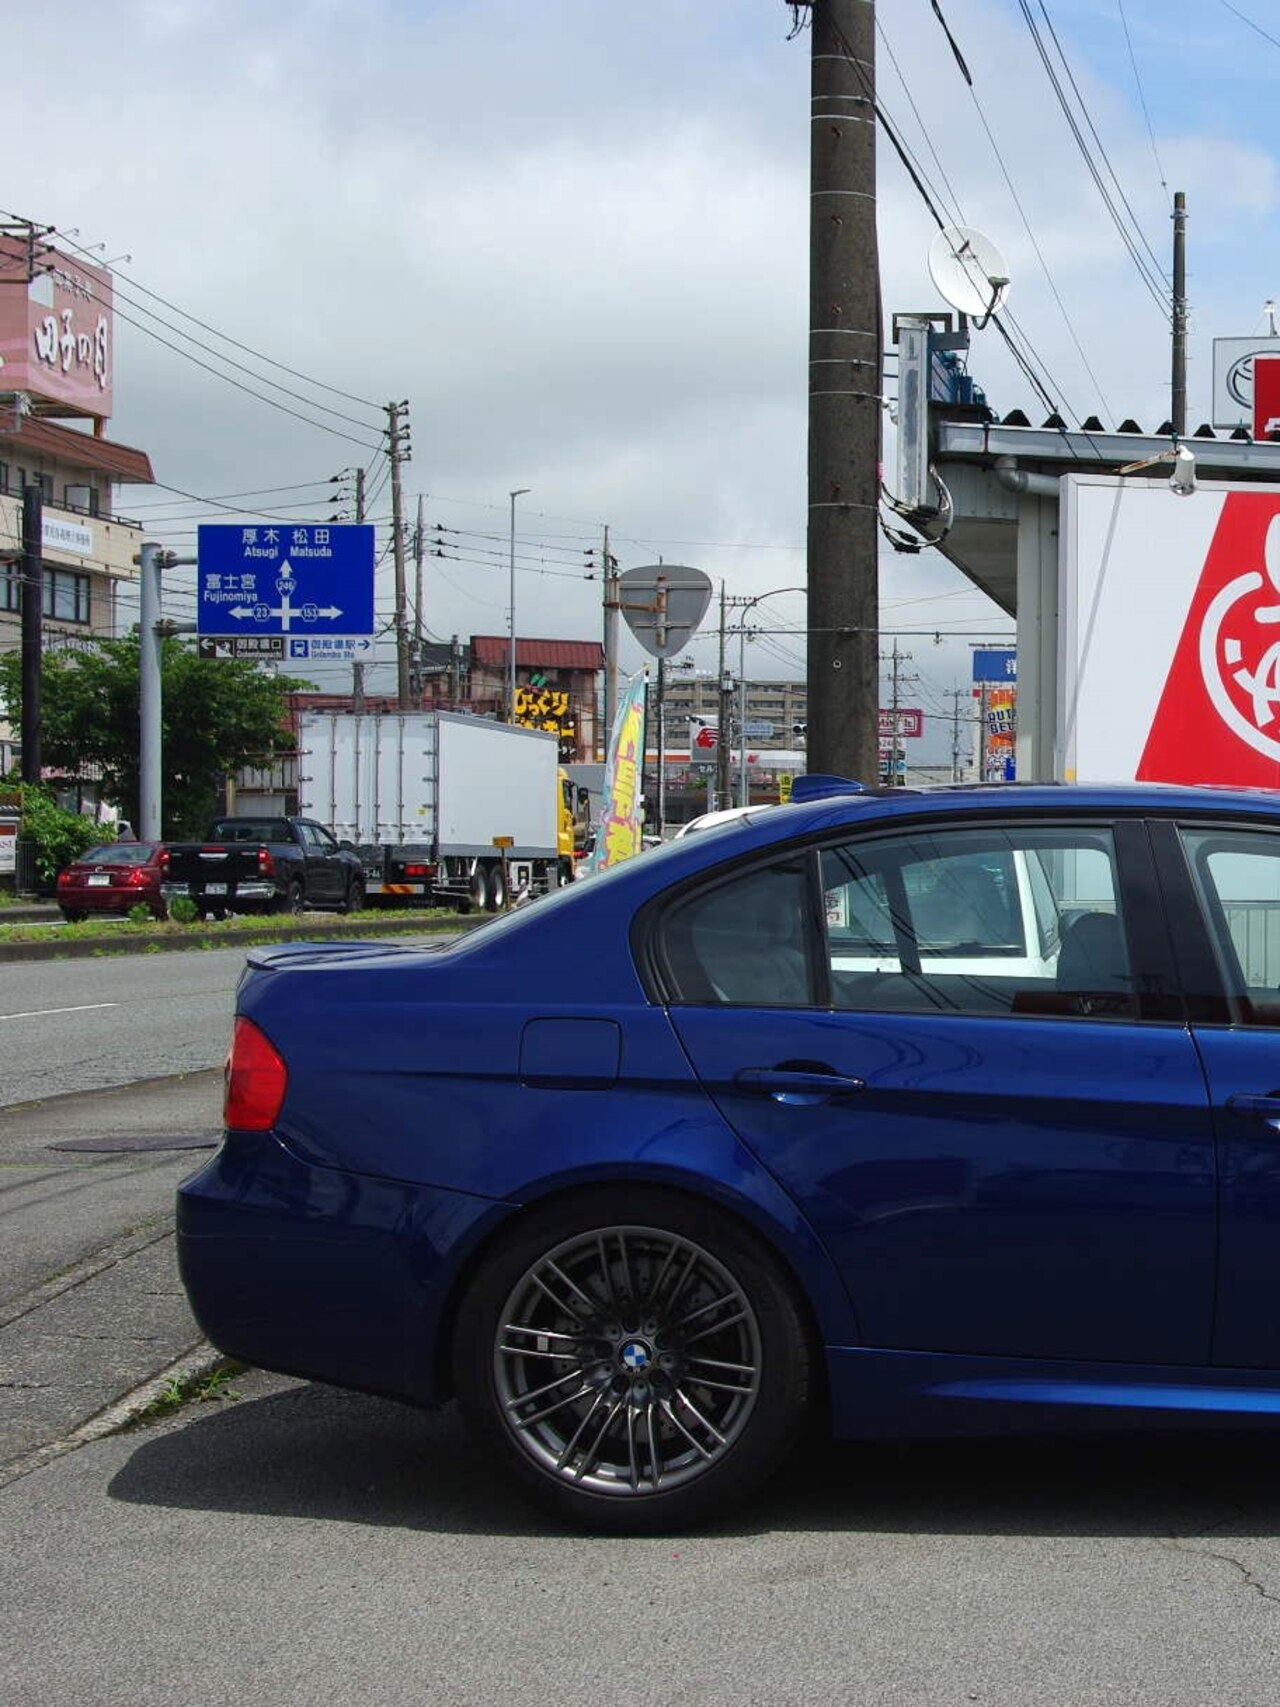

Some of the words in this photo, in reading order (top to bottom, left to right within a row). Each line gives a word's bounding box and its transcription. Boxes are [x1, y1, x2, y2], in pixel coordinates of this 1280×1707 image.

[242, 528, 280, 545] 厚木
[292, 528, 330, 545] 松田
[244, 546, 279, 559] Atsugi
[290, 546, 332, 558] Matsuda
[205, 573, 256, 590] 富士宮
[204, 590, 258, 604] Fujinomiya
[256, 607, 268, 618] 23
